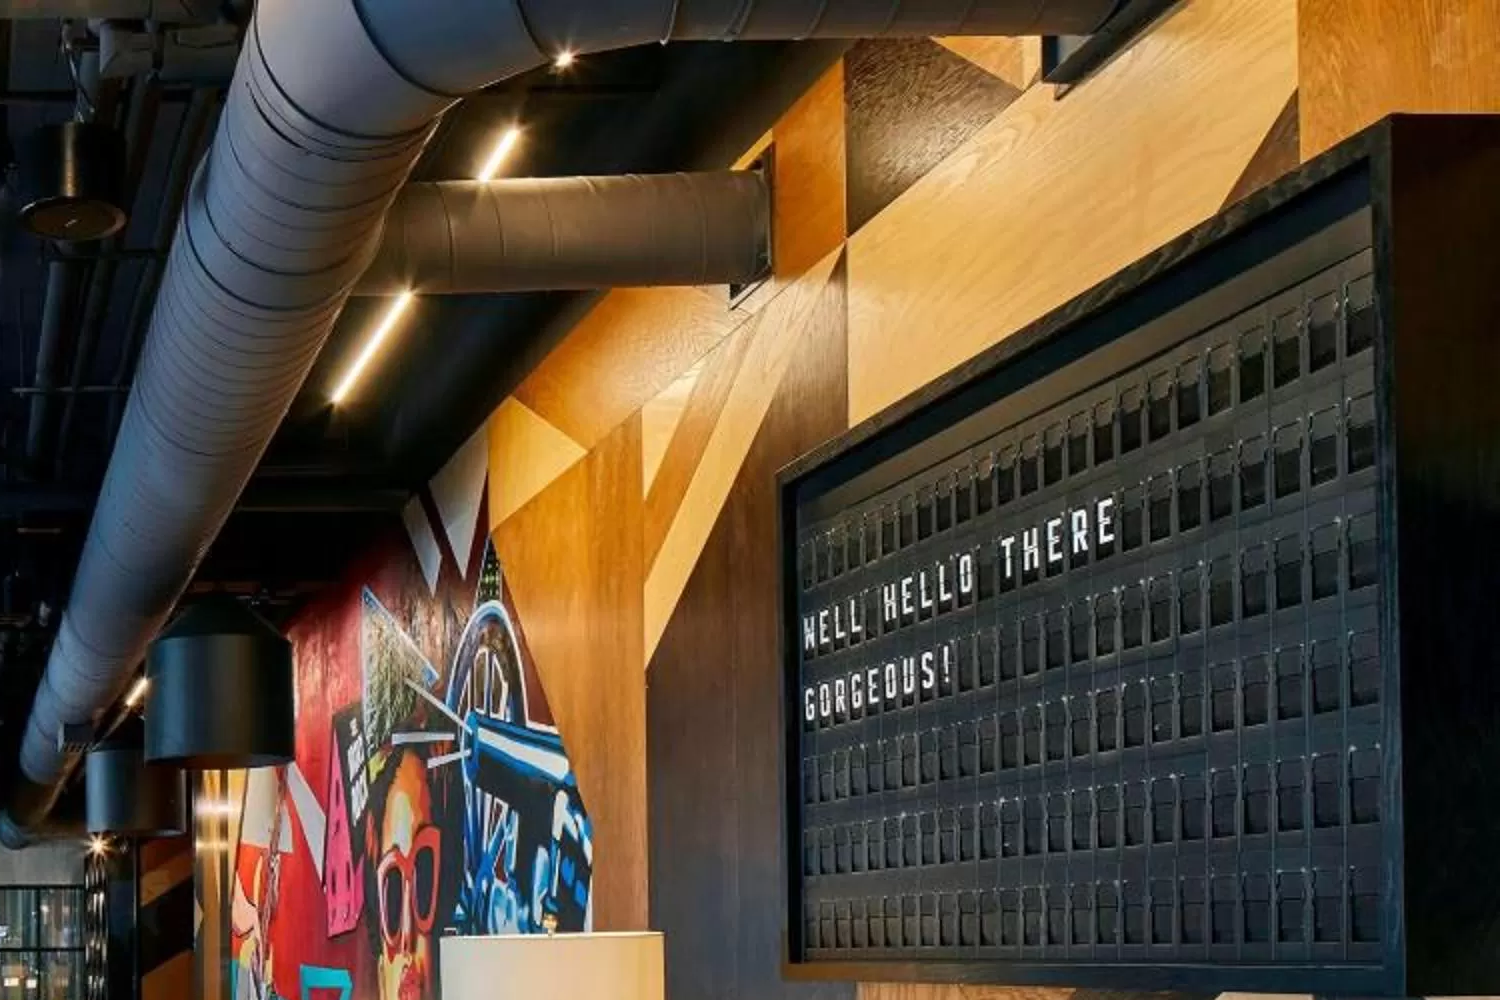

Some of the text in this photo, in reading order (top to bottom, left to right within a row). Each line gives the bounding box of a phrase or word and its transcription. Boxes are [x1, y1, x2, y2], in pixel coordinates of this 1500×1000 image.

[883, 554, 972, 622] HELLO
[1001, 498, 1115, 578] THERE
[805, 646, 950, 721] GORGEOUS!
